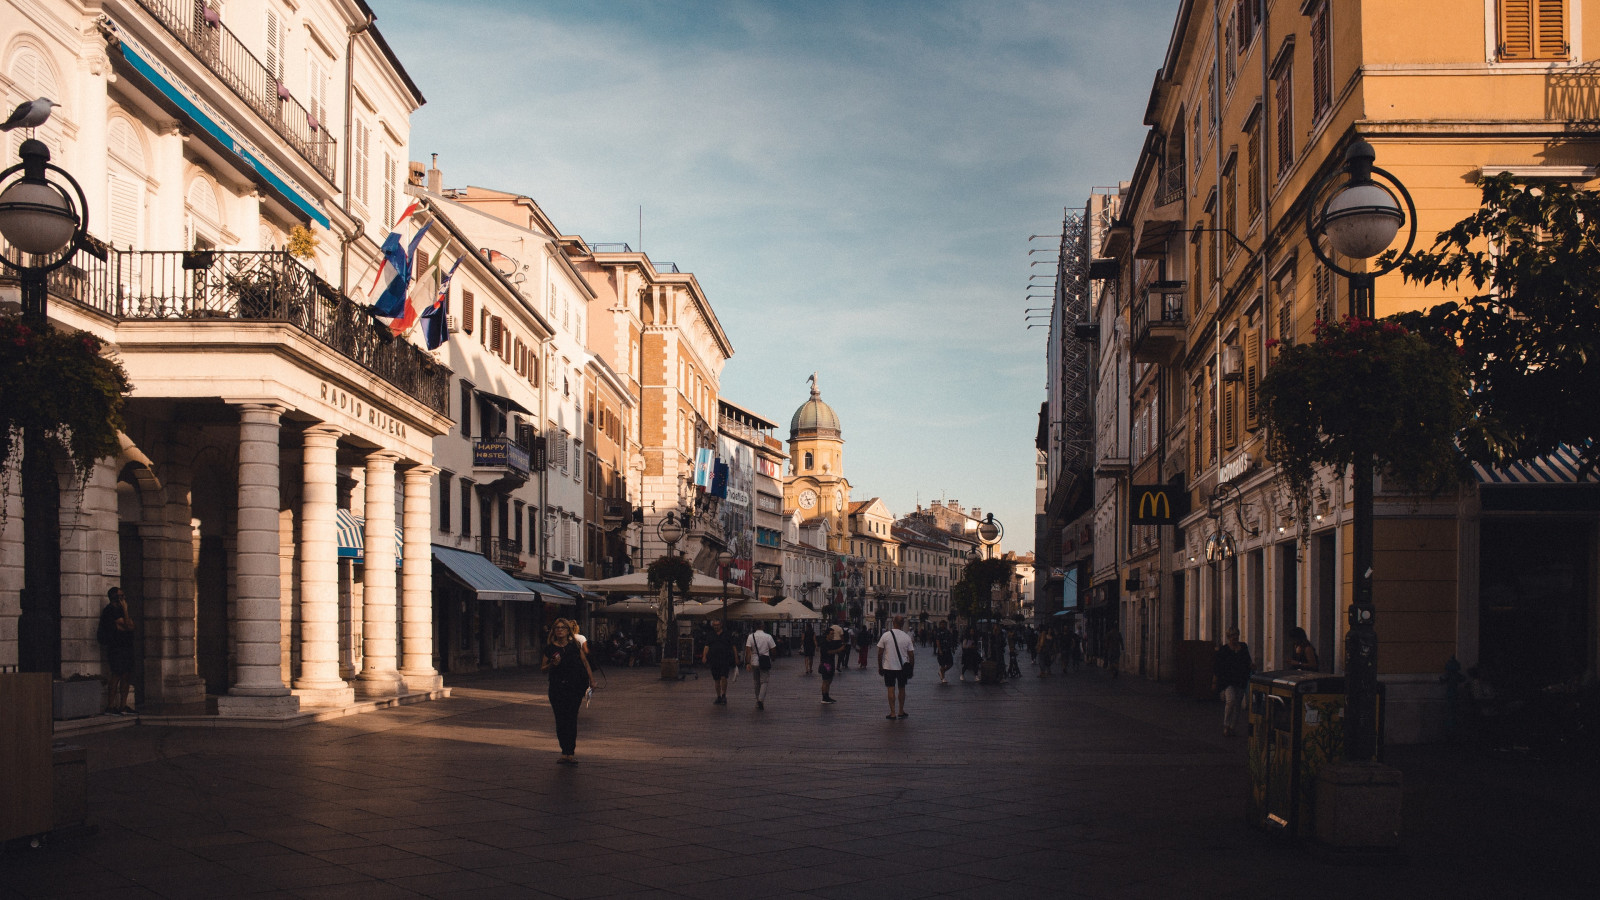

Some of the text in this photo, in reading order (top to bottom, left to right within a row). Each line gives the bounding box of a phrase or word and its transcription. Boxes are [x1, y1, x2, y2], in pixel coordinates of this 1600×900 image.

[320, 382, 407, 440] RADIO RIJEKA
[477, 443, 506, 451] HAPPY
